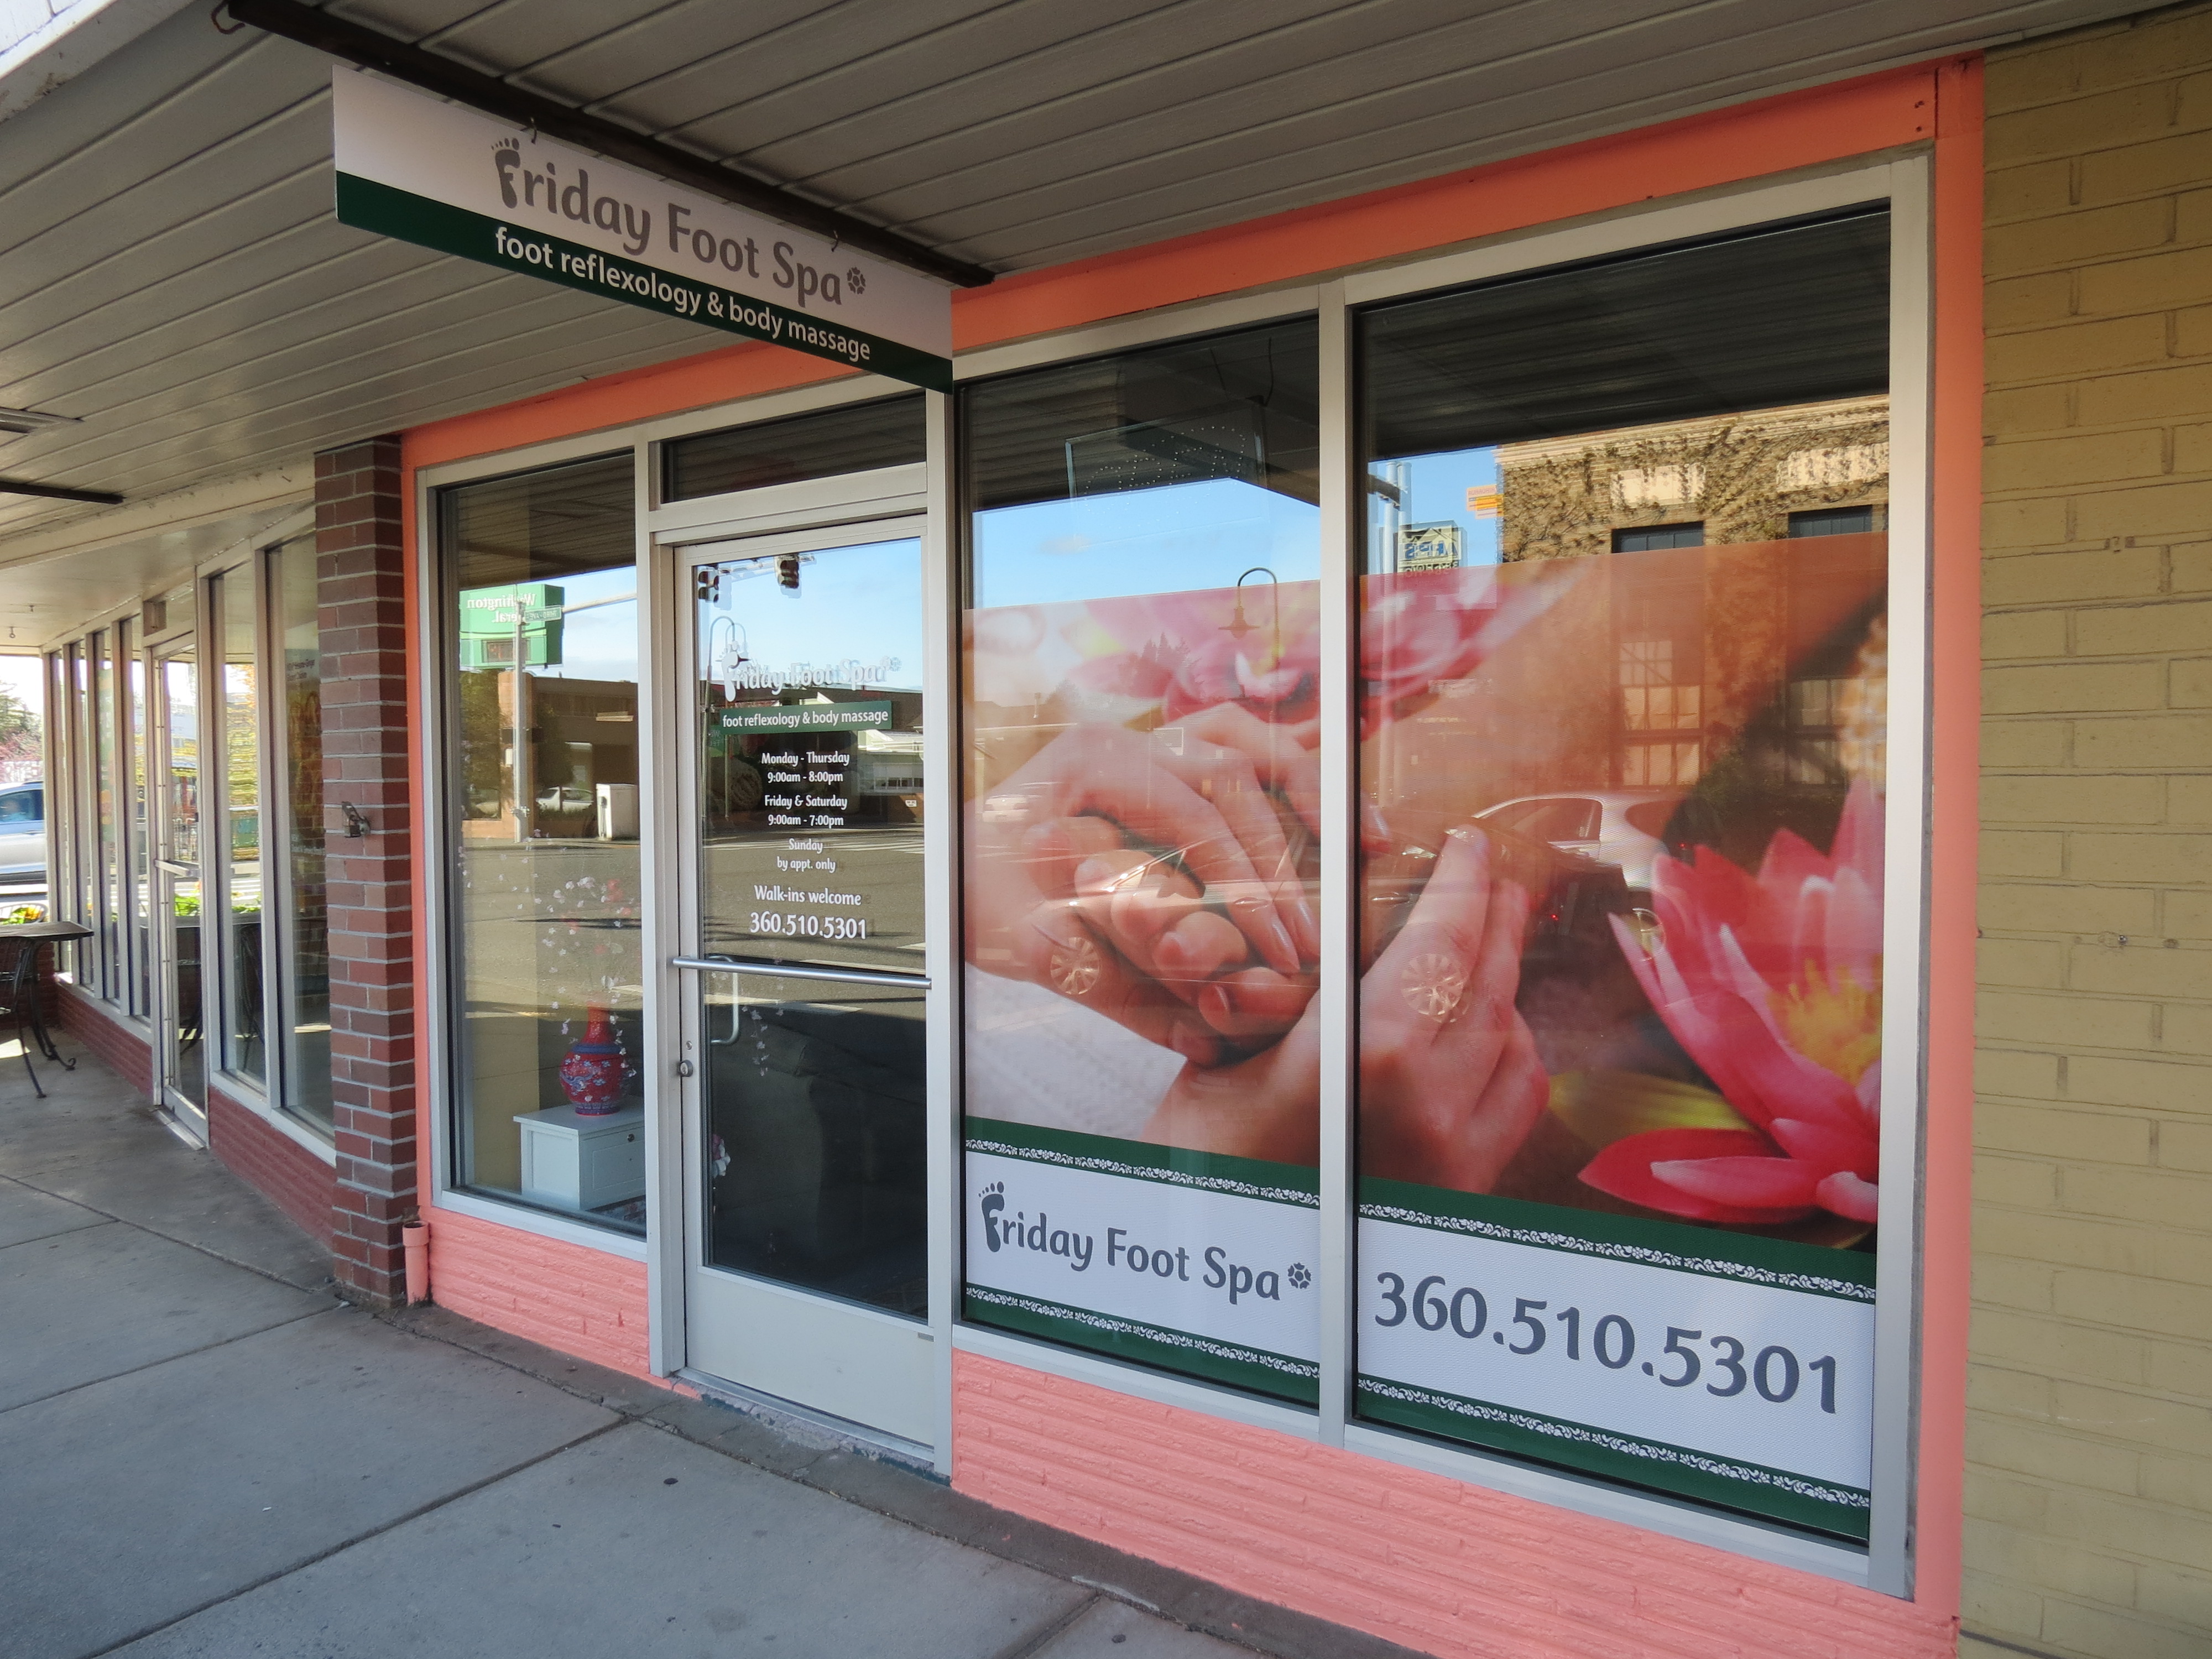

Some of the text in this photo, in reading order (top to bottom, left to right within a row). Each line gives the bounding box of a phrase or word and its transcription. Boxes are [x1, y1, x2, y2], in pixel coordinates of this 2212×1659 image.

[491, 137, 842, 307] Friday Foot Spa
[495, 226, 871, 361] foot reflexology & body massage
[721, 646, 885, 702] Friday Foot Spa
[723, 709, 888, 728] foot reflexology & body massage
[762, 752, 799, 766] Monday
[806, 751, 850, 766] Thursday
[768, 772, 801, 783] 9:00am
[808, 771, 843, 785] 8:00pm
[764, 795, 847, 810] Friday & Saturday
[768, 815, 801, 826] 9:00am
[810, 815, 844, 828] 7:00pm
[789, 838, 823, 853] Sunday
[777, 856, 836, 873] by appt. only
[754, 885, 861, 905] Walk-ins welcome
[750, 911, 867, 940] 360.510.5301
[978, 1181, 1280, 1305] Friday Foot Spa
[1374, 1272, 1836, 1413] 360.510.5301
